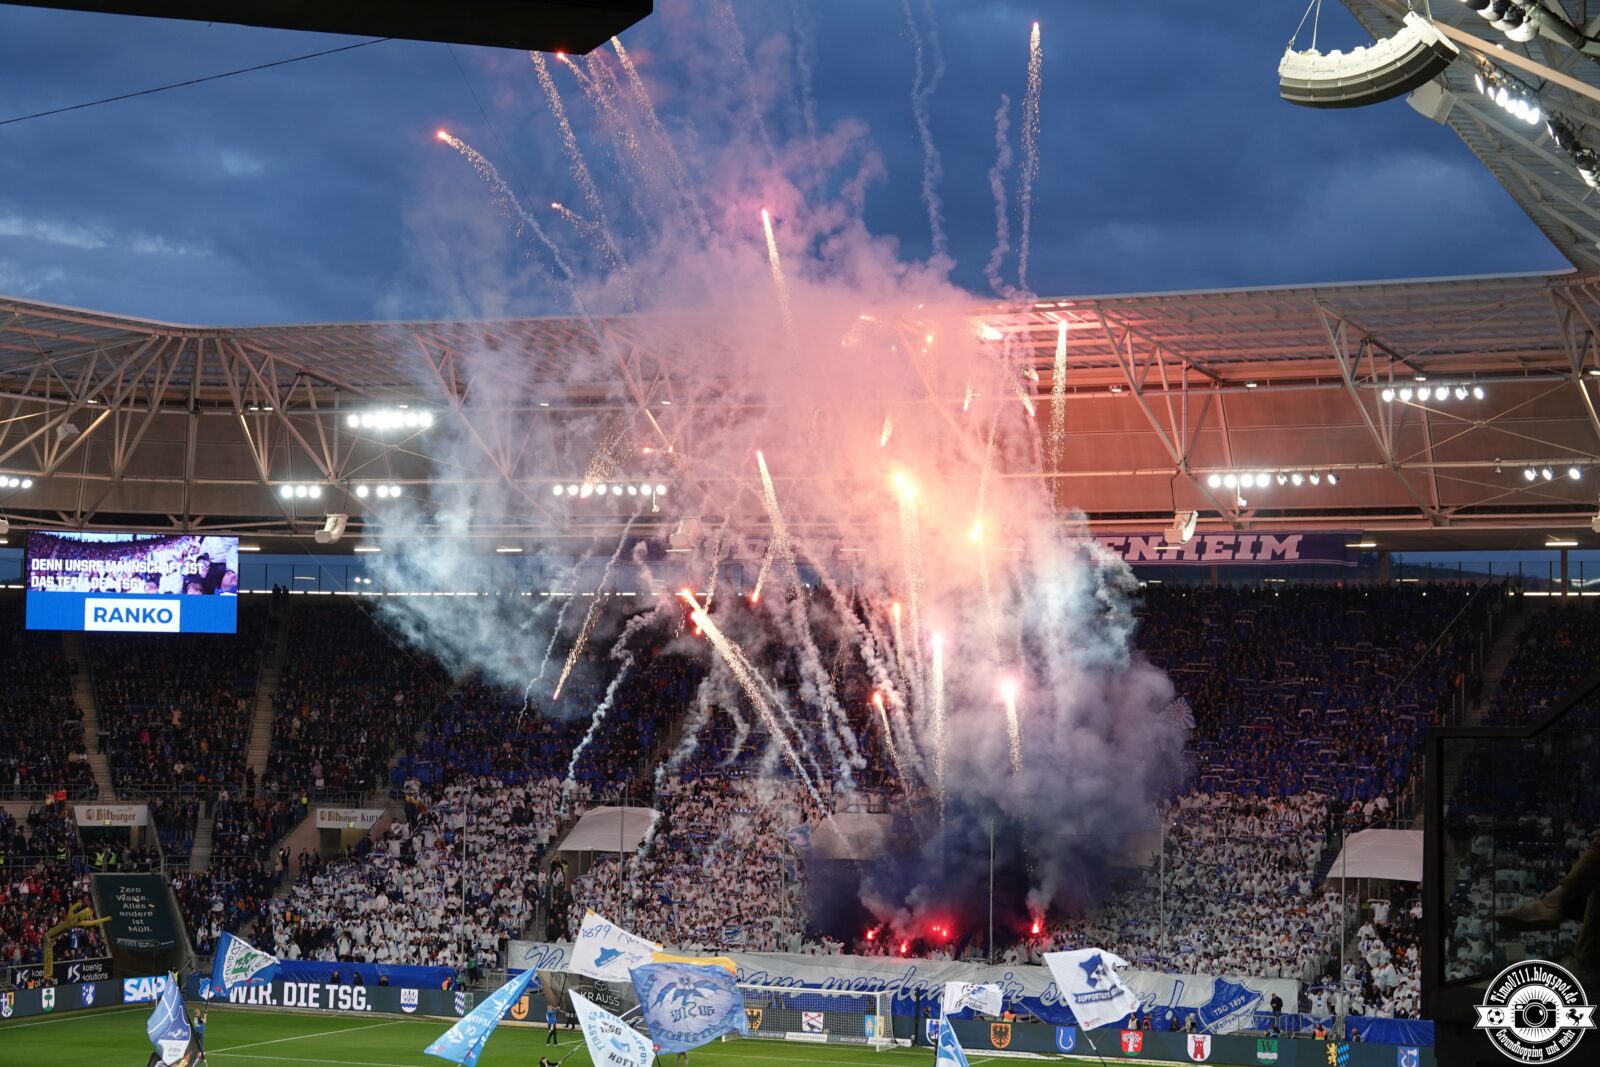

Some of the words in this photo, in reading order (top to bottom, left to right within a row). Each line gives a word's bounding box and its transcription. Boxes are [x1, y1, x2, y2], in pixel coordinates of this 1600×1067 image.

[1096, 534, 1303, 561] ENHEIM
[31, 558, 63, 571] DENN
[65, 559, 103, 572] UNSRE
[105, 560, 181, 574] MANNSCHAFT
[184, 563, 204, 575] IST
[31, 576, 54, 588] DAS
[56, 577, 89, 589] TEAM
[94, 607, 173, 624] RANKO
[96, 806, 137, 822] Bitburger
[328, 810, 358, 823] Bitburger
[361, 812, 381, 823] Kurv
[122, 902, 147, 910] Alles
[128, 925, 153, 933] Müll.
[582, 924, 612, 939] 1899
[82, 963, 103, 972] koenig
[82, 972, 109, 982] solutions
[124, 978, 167, 1002] SAP
[229, 983, 277, 1006] WIR.
[283, 982, 320, 1008] DIE
[326, 984, 371, 1011] TSG.
[580, 991, 620, 1006] KRAUSS
[1213, 1005, 1229, 1016] TSG
